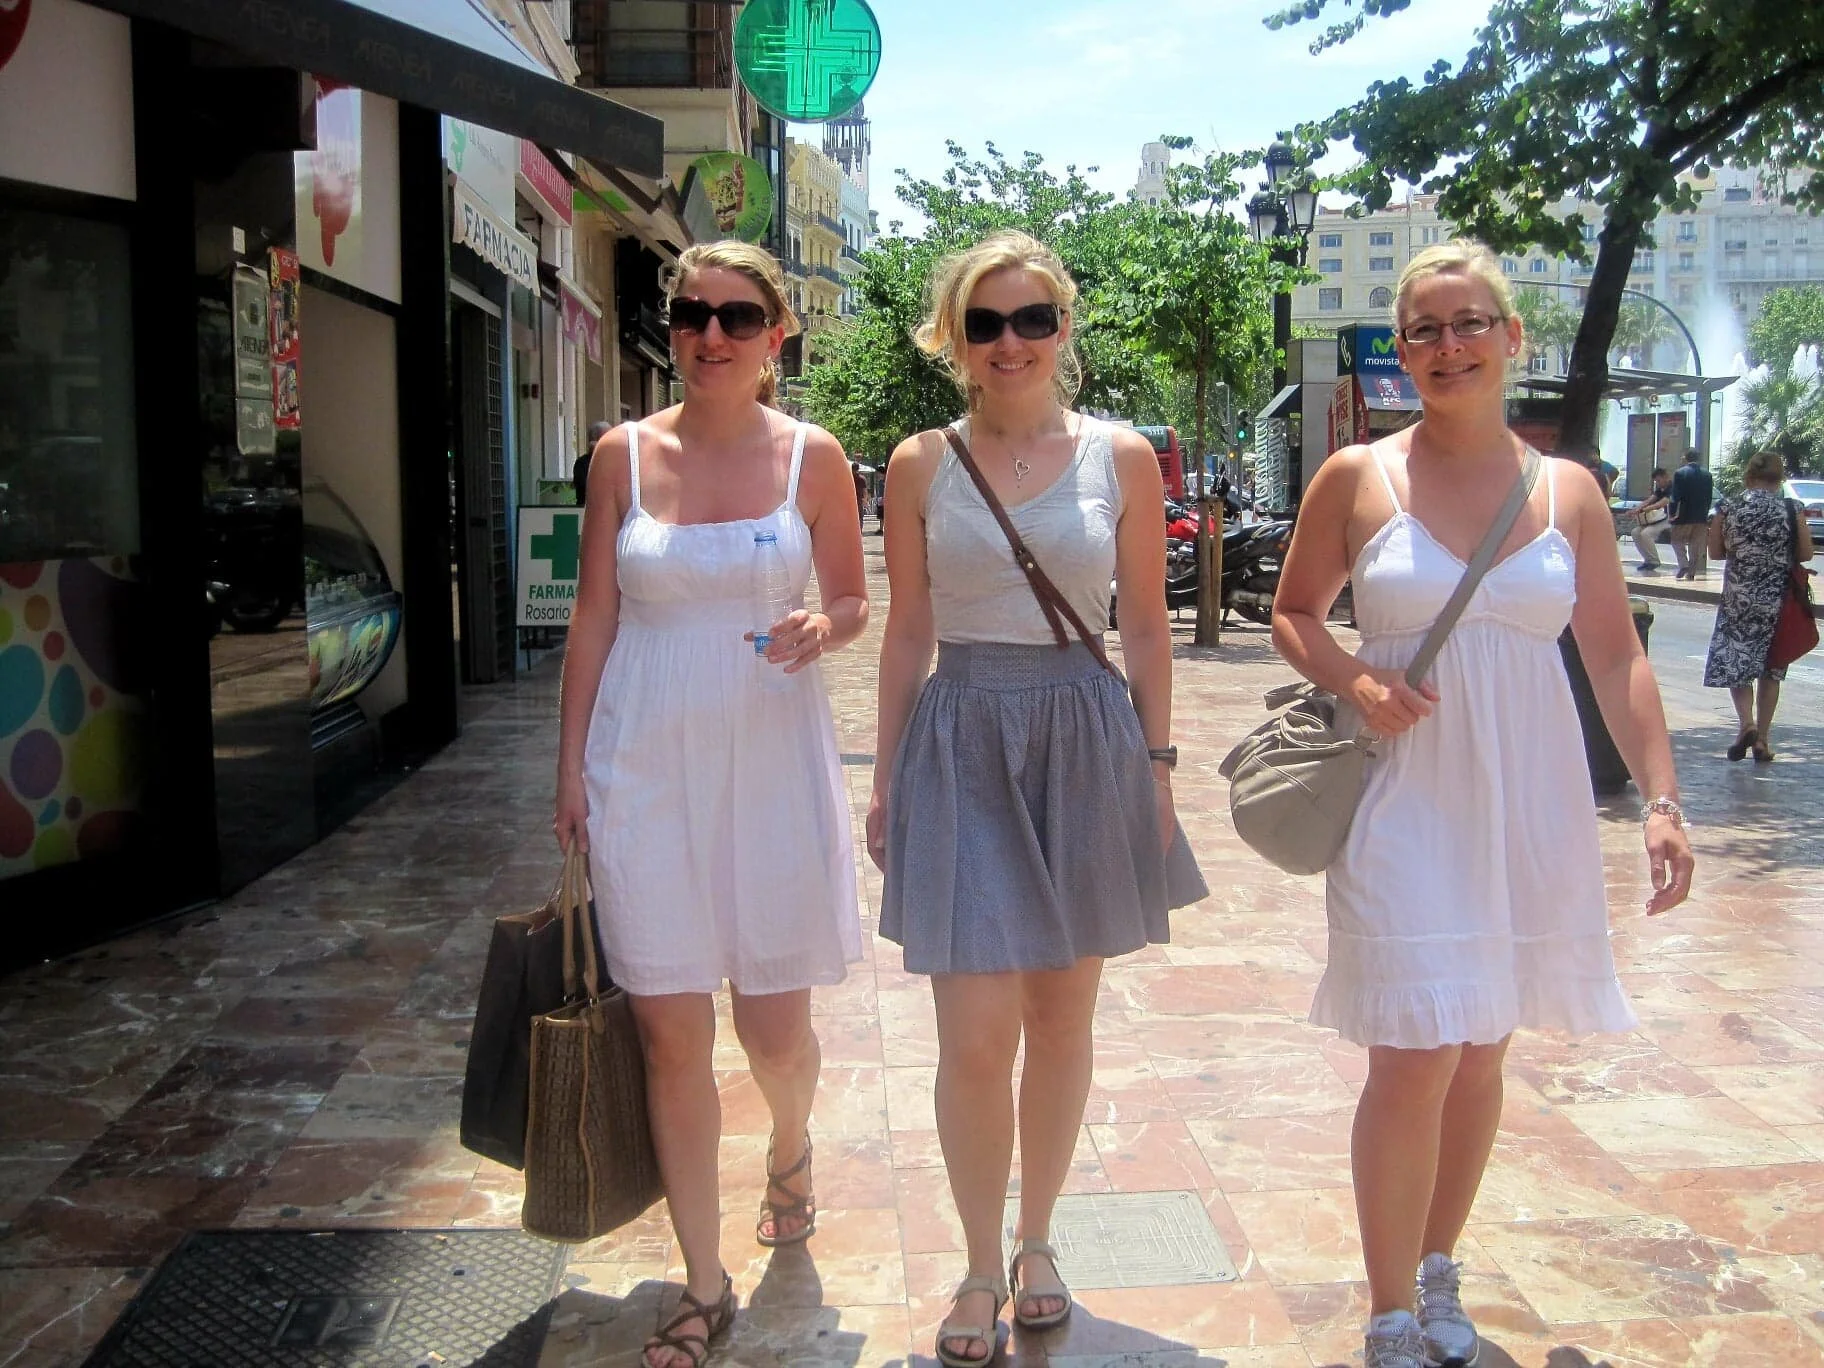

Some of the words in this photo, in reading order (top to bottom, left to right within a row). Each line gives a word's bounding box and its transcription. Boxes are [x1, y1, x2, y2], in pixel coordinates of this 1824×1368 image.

[464, 203, 531, 280] FARMACIA
[1365, 357, 1400, 366] movista
[529, 584, 577, 599] FARMA
[525, 604, 570, 620] Rosario
